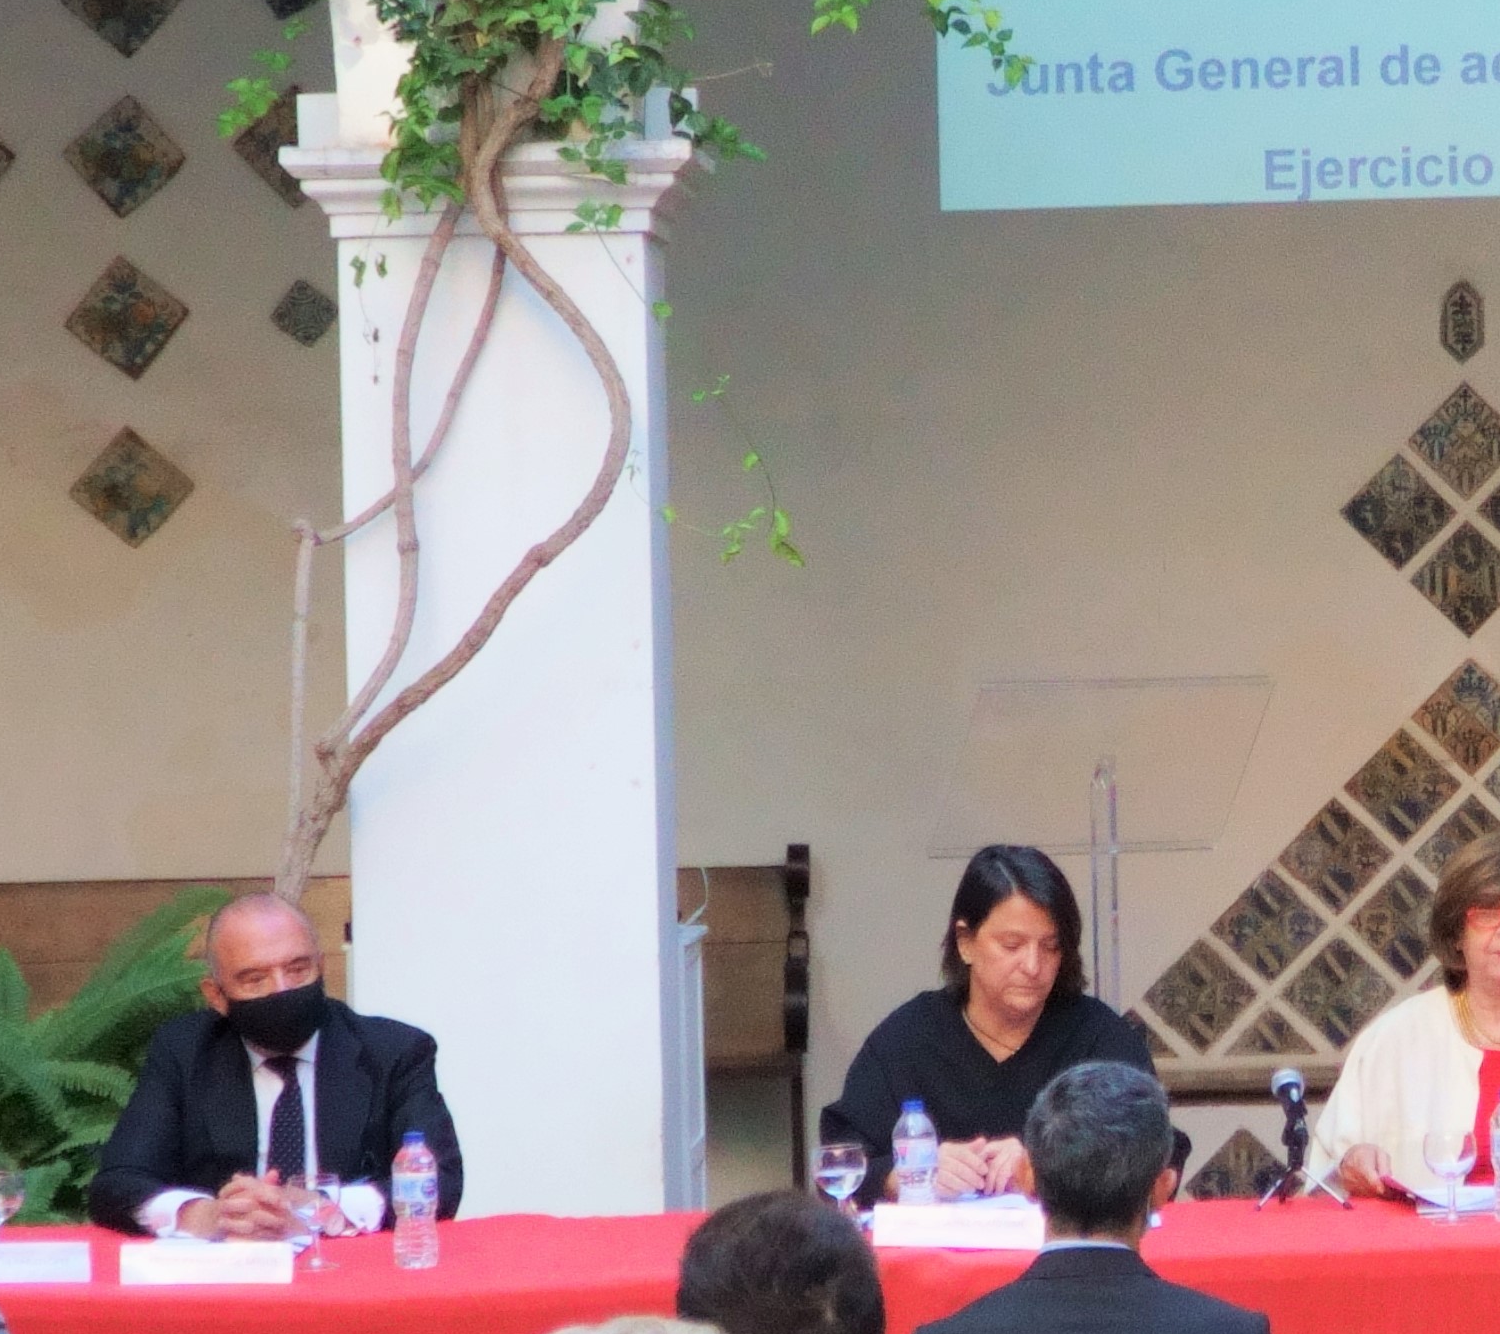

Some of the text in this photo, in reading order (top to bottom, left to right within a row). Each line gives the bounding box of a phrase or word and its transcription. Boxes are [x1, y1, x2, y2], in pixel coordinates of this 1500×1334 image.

[1154, 45, 1361, 92] General
[1379, 43, 1442, 86] de
[1263, 144, 1494, 203] Ejercicio
